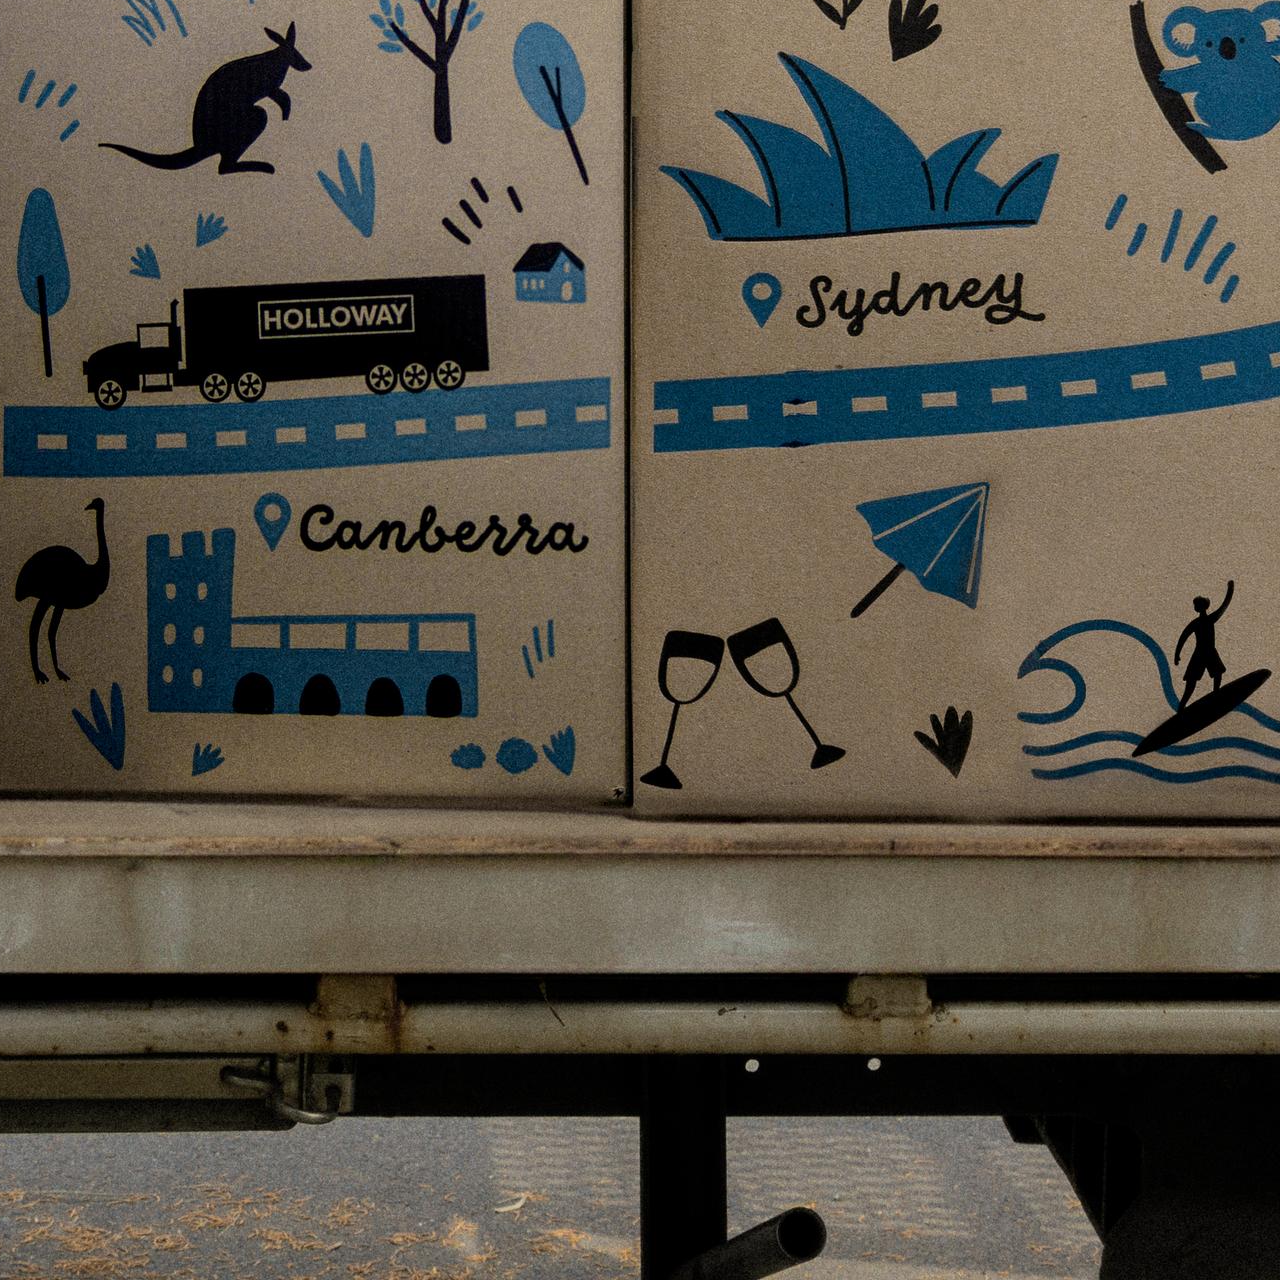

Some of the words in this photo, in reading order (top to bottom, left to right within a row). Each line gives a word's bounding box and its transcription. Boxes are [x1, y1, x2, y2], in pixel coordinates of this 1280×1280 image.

[263, 303, 408, 331] HOLLOWAY
[795, 271, 1046, 337] Sydney
[299, 503, 589, 558] Canberra
